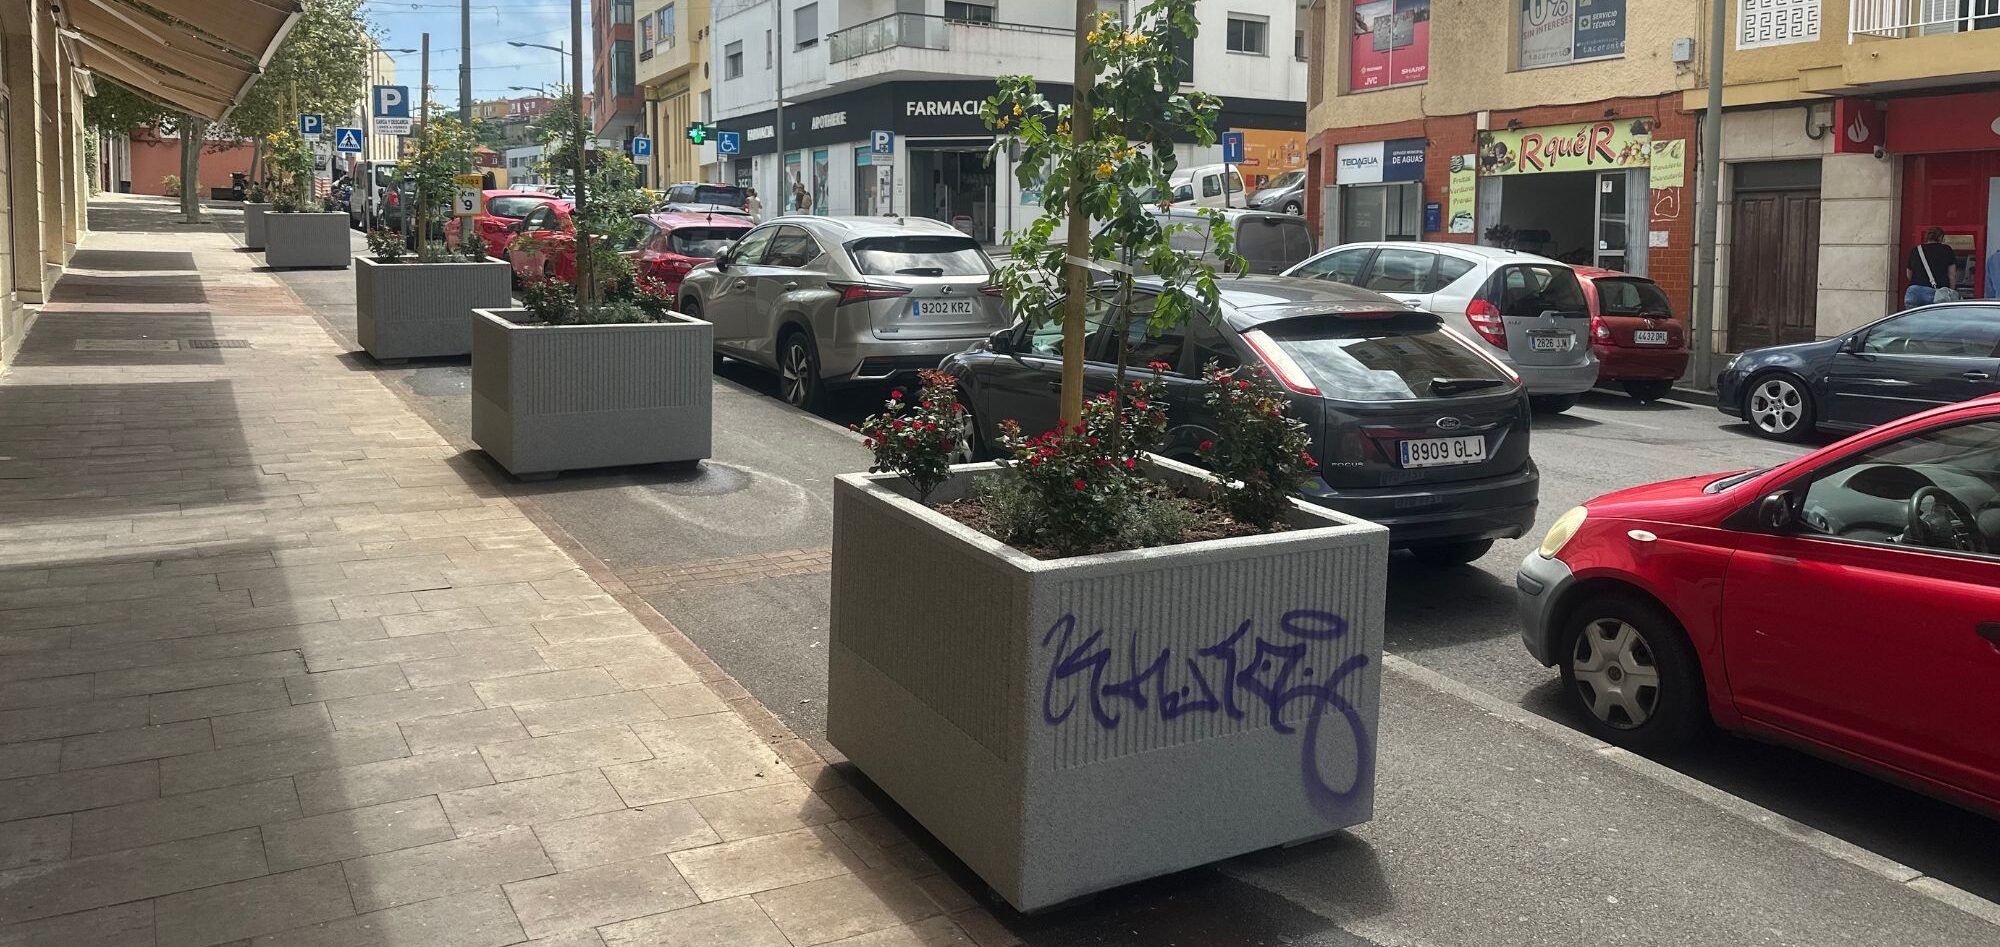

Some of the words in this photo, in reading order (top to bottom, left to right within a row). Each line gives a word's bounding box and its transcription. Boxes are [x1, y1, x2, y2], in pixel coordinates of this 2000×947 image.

[1592, 10, 1617, 20] SERVICIO
[1523, 30, 1535, 40] SIN
[1535, 14, 1574, 35] INTERESES
[1592, 19, 1616, 29] TÉCNICO
[1401, 65, 1425, 75] SHARP
[1364, 76, 1378, 86] JVC
[380, 88, 402, 115] P
[906, 100, 987, 116] FARMACIA
[304, 116, 317, 131] P
[875, 132, 889, 150] P
[638, 142, 647, 154] P
[1392, 156, 1401, 164] DE
[1401, 155, 1424, 163] AGUAS
[464, 200, 473, 211] 9
[921, 302, 948, 314] 9202
[951, 302, 971, 313] KRZ
[1536, 338, 1554, 348] 2826
[1411, 440, 1449, 461] 8909
[1454, 439, 1482, 458] GLJ
